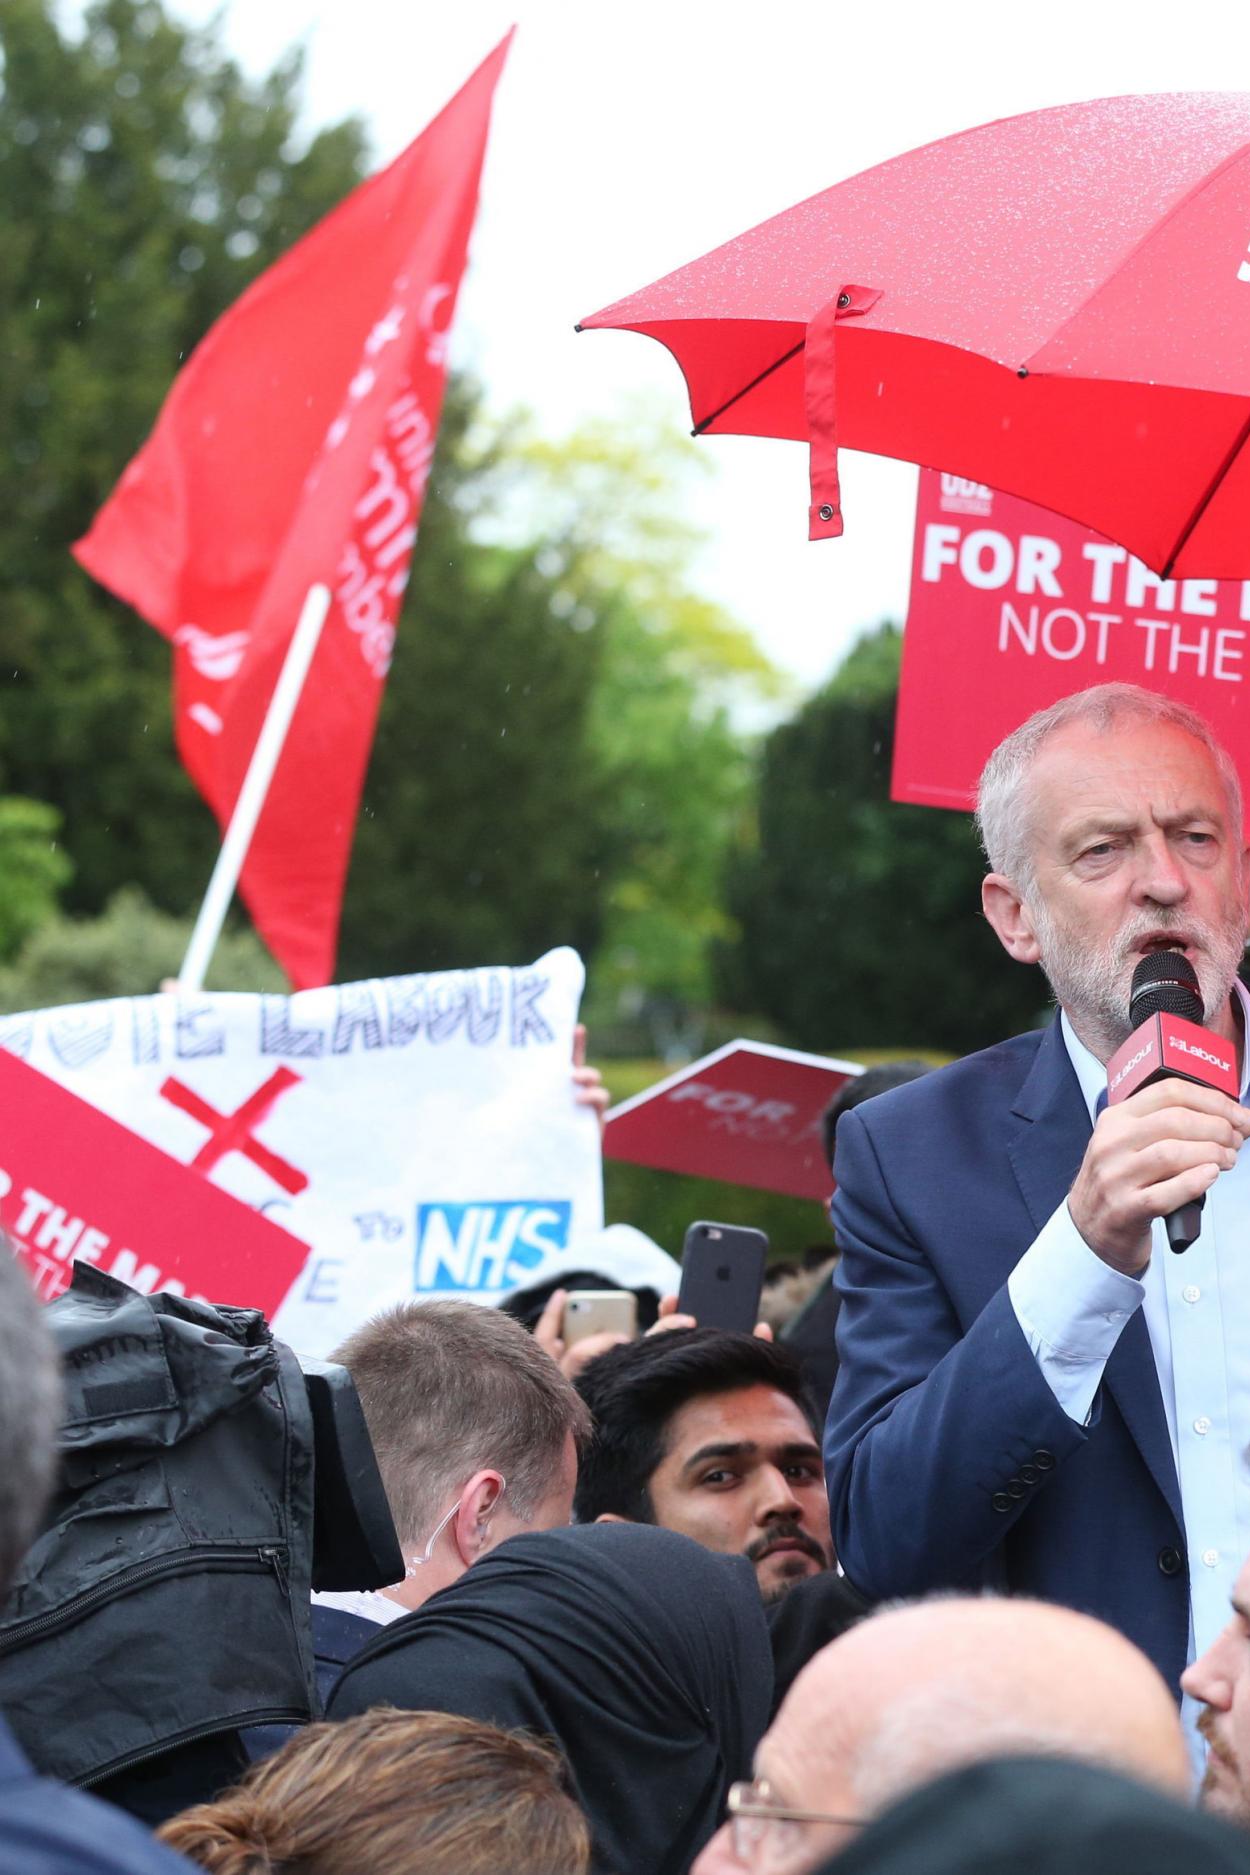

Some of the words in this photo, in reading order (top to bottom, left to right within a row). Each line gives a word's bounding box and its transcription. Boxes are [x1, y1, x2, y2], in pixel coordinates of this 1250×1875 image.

[921, 523, 1064, 597] FOR
[1082, 542, 1218, 617] THE
[998, 602, 1123, 664] NOT
[1135, 618, 1246, 681] THE
[1181, 1040, 1232, 1072] Labour
[15, 1186, 111, 1265] THE
[418, 1206, 562, 1289] NHS
